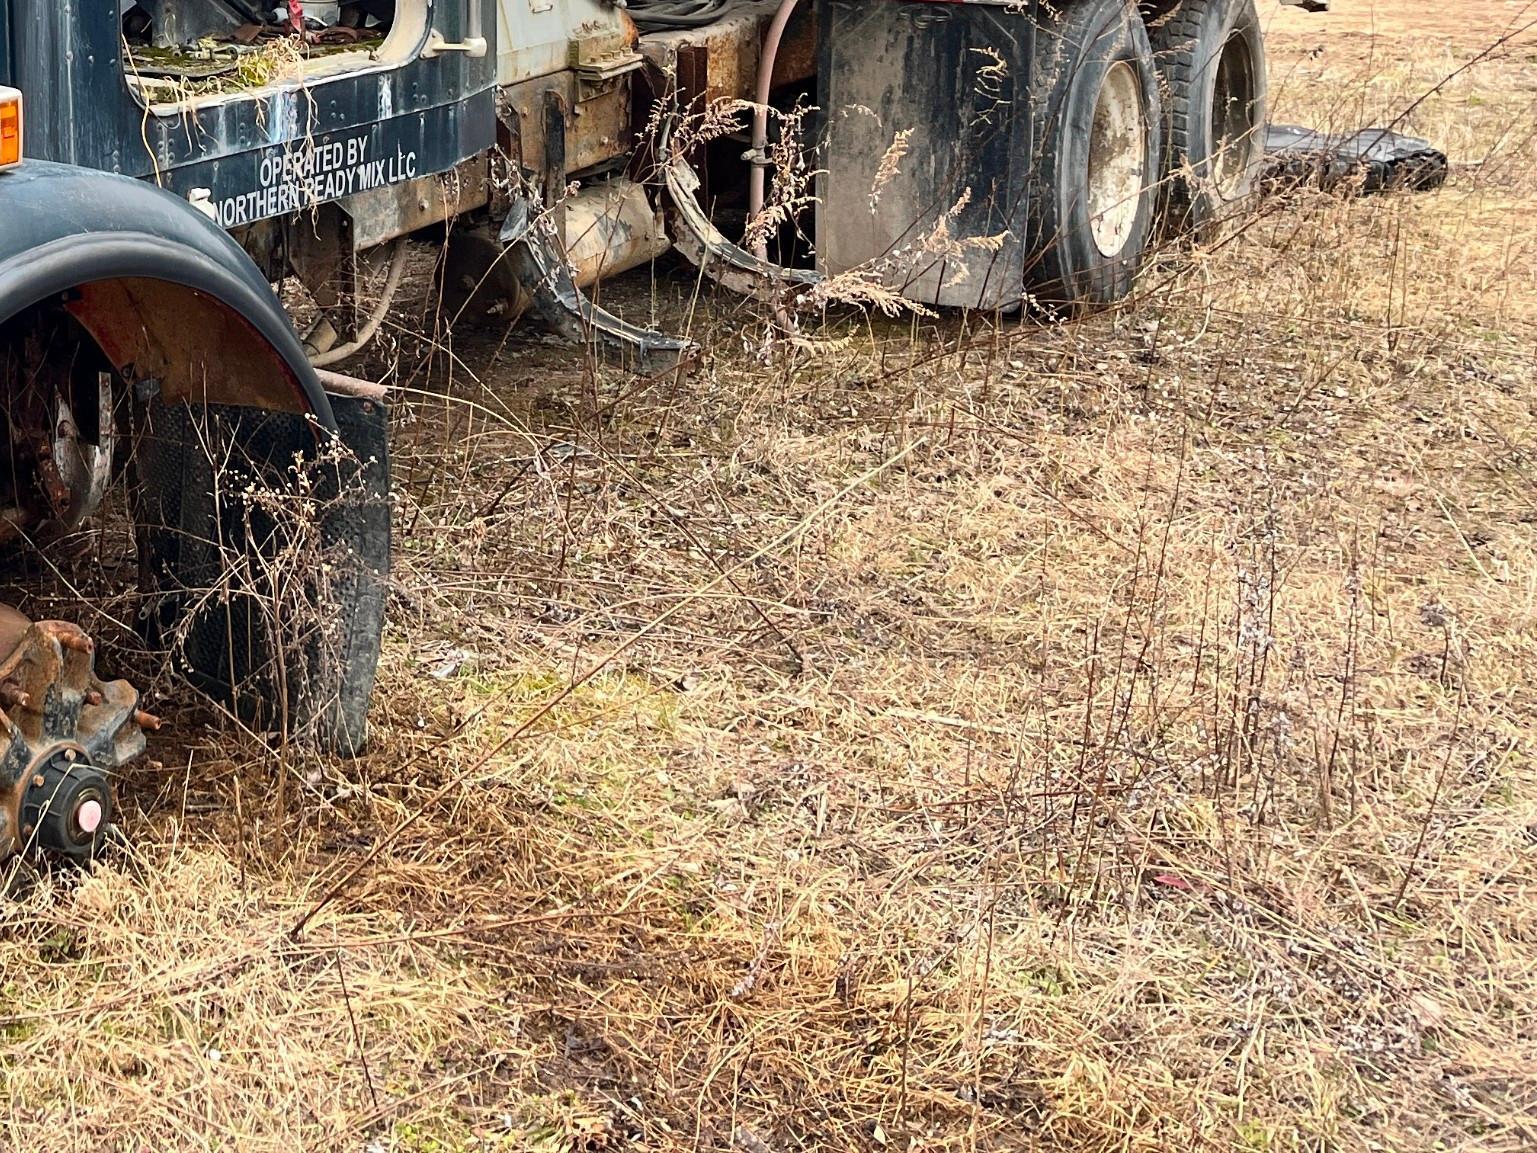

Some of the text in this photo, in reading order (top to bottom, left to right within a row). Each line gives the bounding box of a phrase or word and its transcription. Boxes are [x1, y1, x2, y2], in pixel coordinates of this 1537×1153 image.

[212, 150, 416, 227] NORTHERN READY MIX LLC
[260, 135, 369, 187] OPERATED BY
